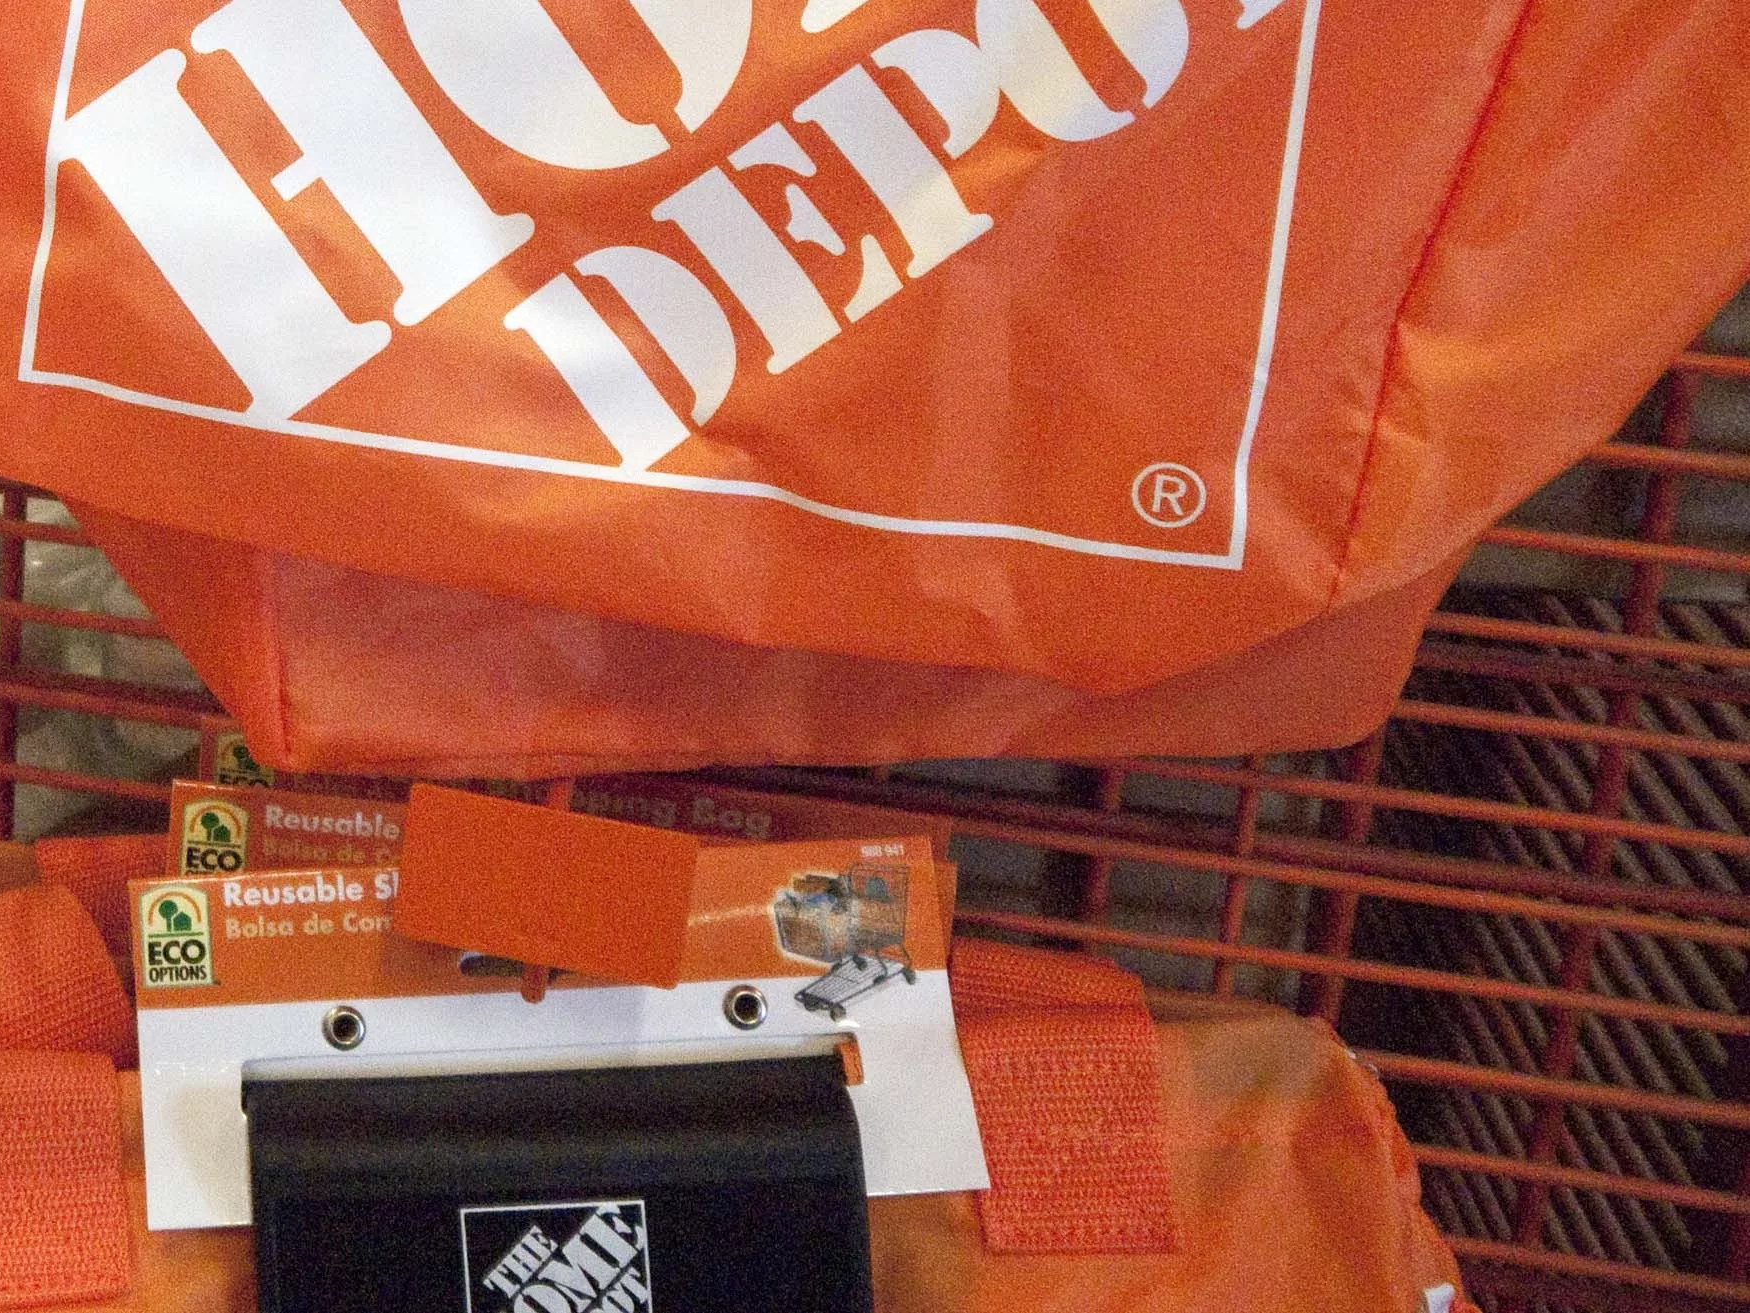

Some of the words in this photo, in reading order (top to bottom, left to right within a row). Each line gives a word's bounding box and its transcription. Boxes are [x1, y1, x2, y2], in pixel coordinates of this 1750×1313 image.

[264, 803, 401, 840] Reusable
[185, 846, 243, 872] ECO
[222, 874, 364, 908] Reusable
[225, 914, 295, 939] Bolsa
[302, 912, 336, 936] de
[147, 938, 207, 967] ECO
[148, 964, 208, 984] OPTIONS
[482, 1224, 559, 1299] THE
